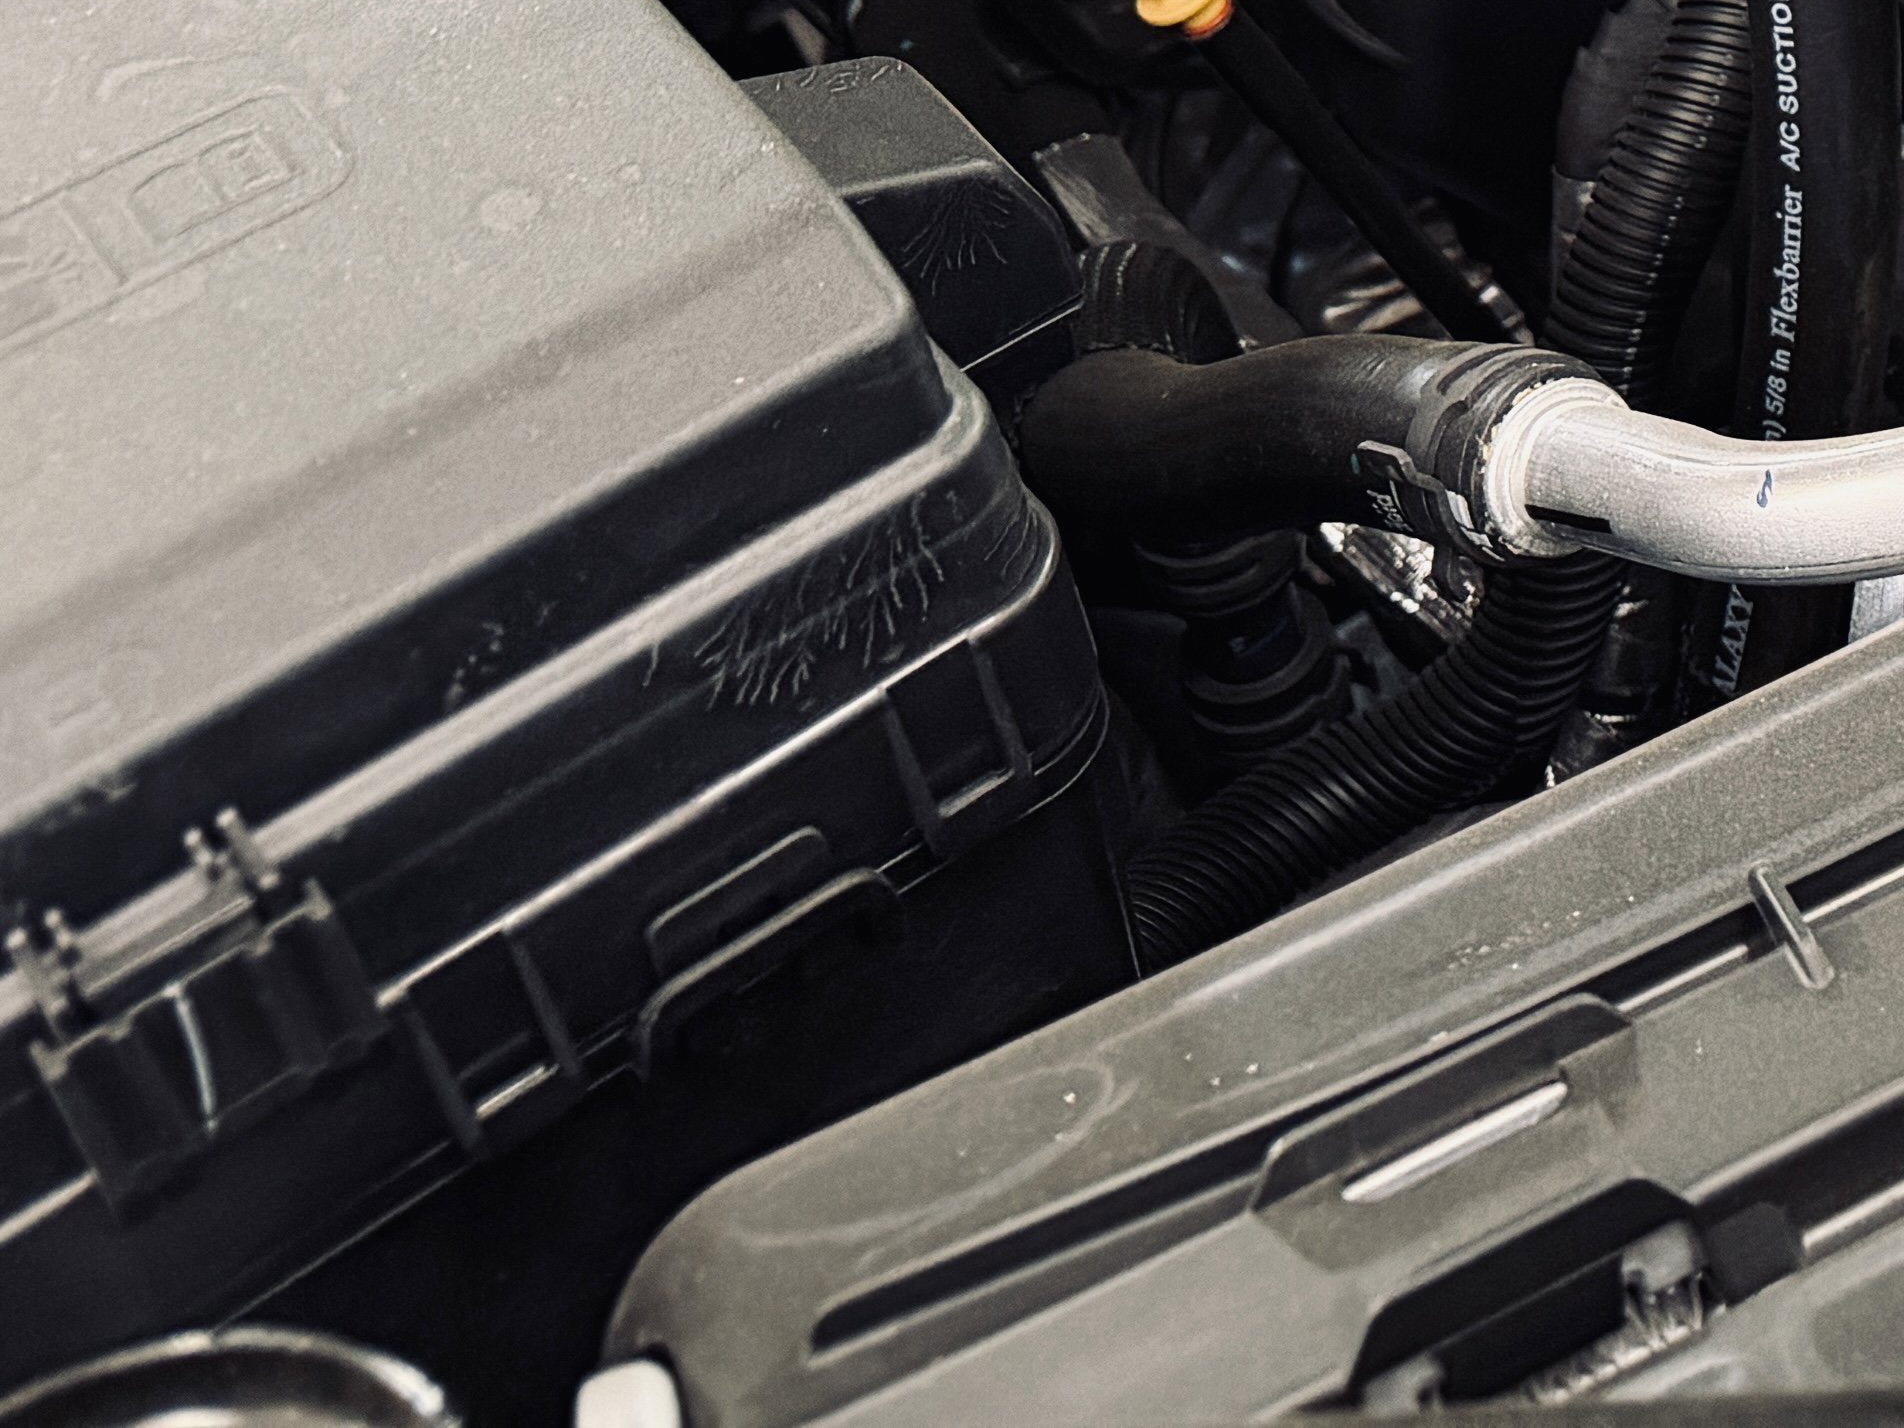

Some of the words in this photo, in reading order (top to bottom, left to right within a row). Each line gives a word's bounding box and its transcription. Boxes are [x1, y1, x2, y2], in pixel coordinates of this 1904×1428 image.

[1778, 121, 1803, 173] A/C
[1769, 183, 1803, 343] Flexbarrier
[1769, 348, 1792, 373] in
[1764, 374, 1787, 416] 5/8
[1710, 583, 1755, 698] ALAXY
